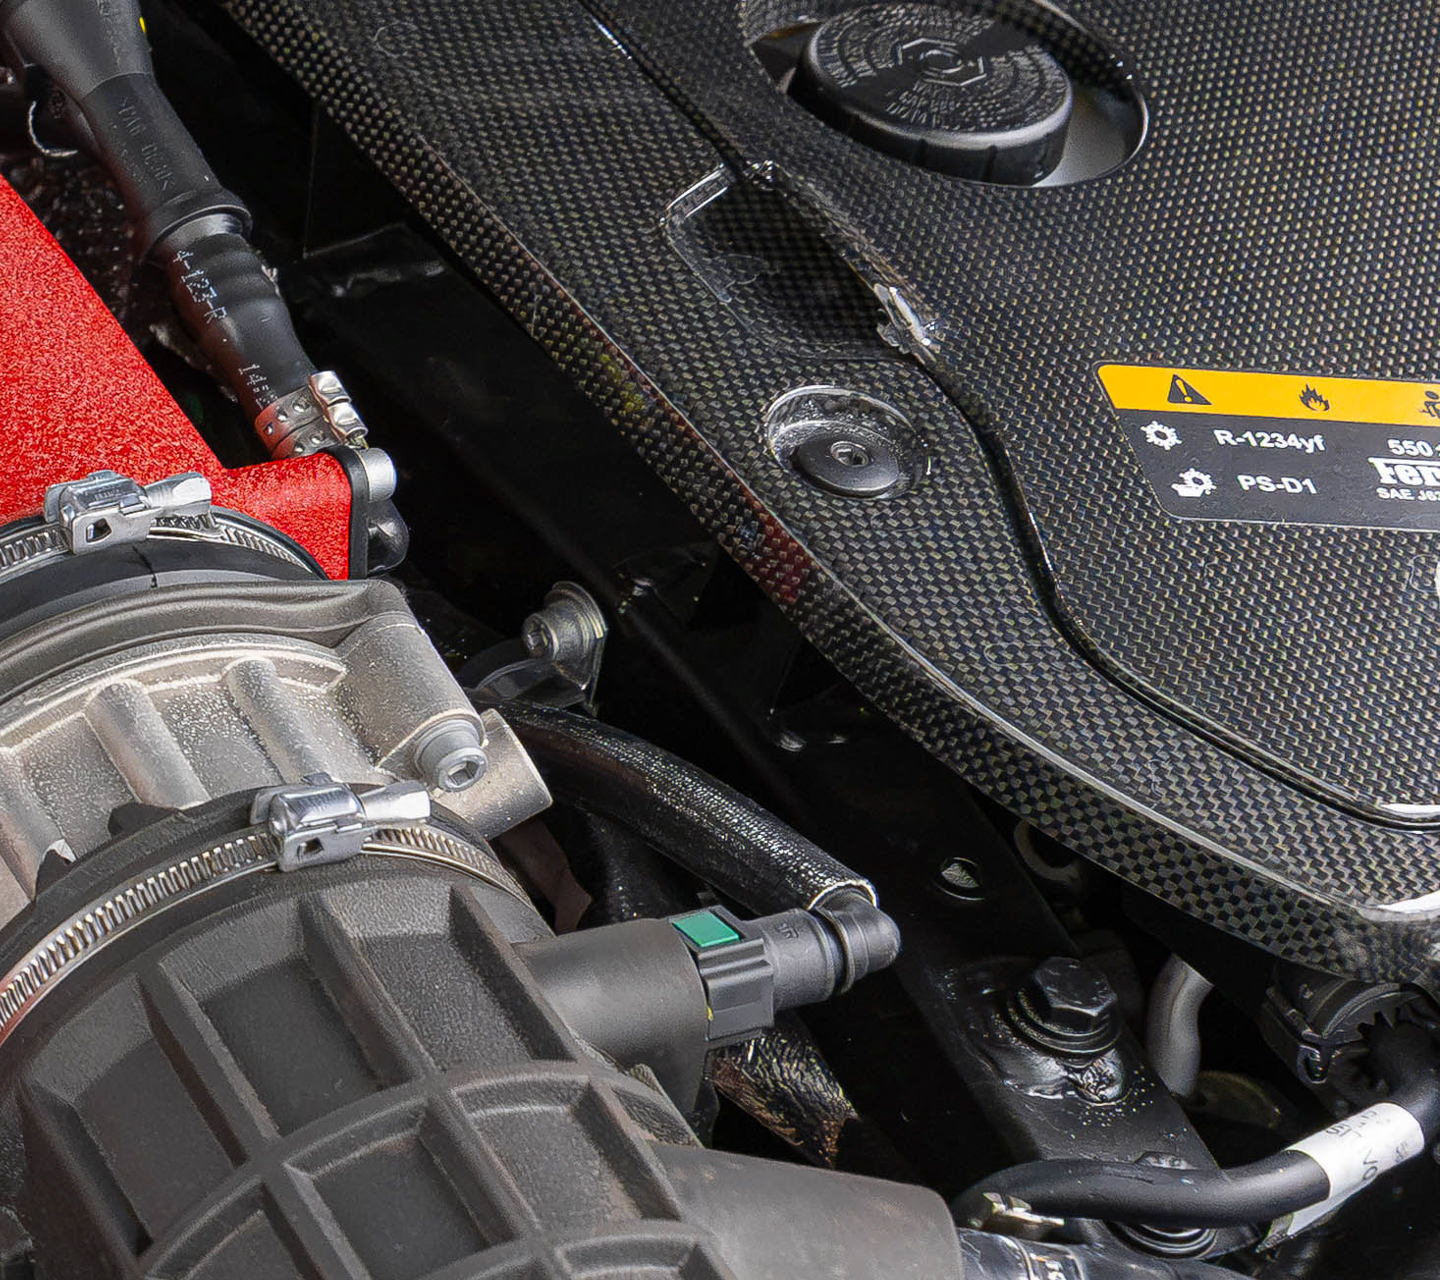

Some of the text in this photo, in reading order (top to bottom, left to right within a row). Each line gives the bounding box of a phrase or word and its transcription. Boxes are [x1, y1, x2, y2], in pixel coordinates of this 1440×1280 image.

[1213, 428, 1327, 454] R-1234yf
[1386, 439, 1434, 457] 550
[1236, 474, 1318, 495] PS-D1
[1376, 487, 1416, 501] SAE
